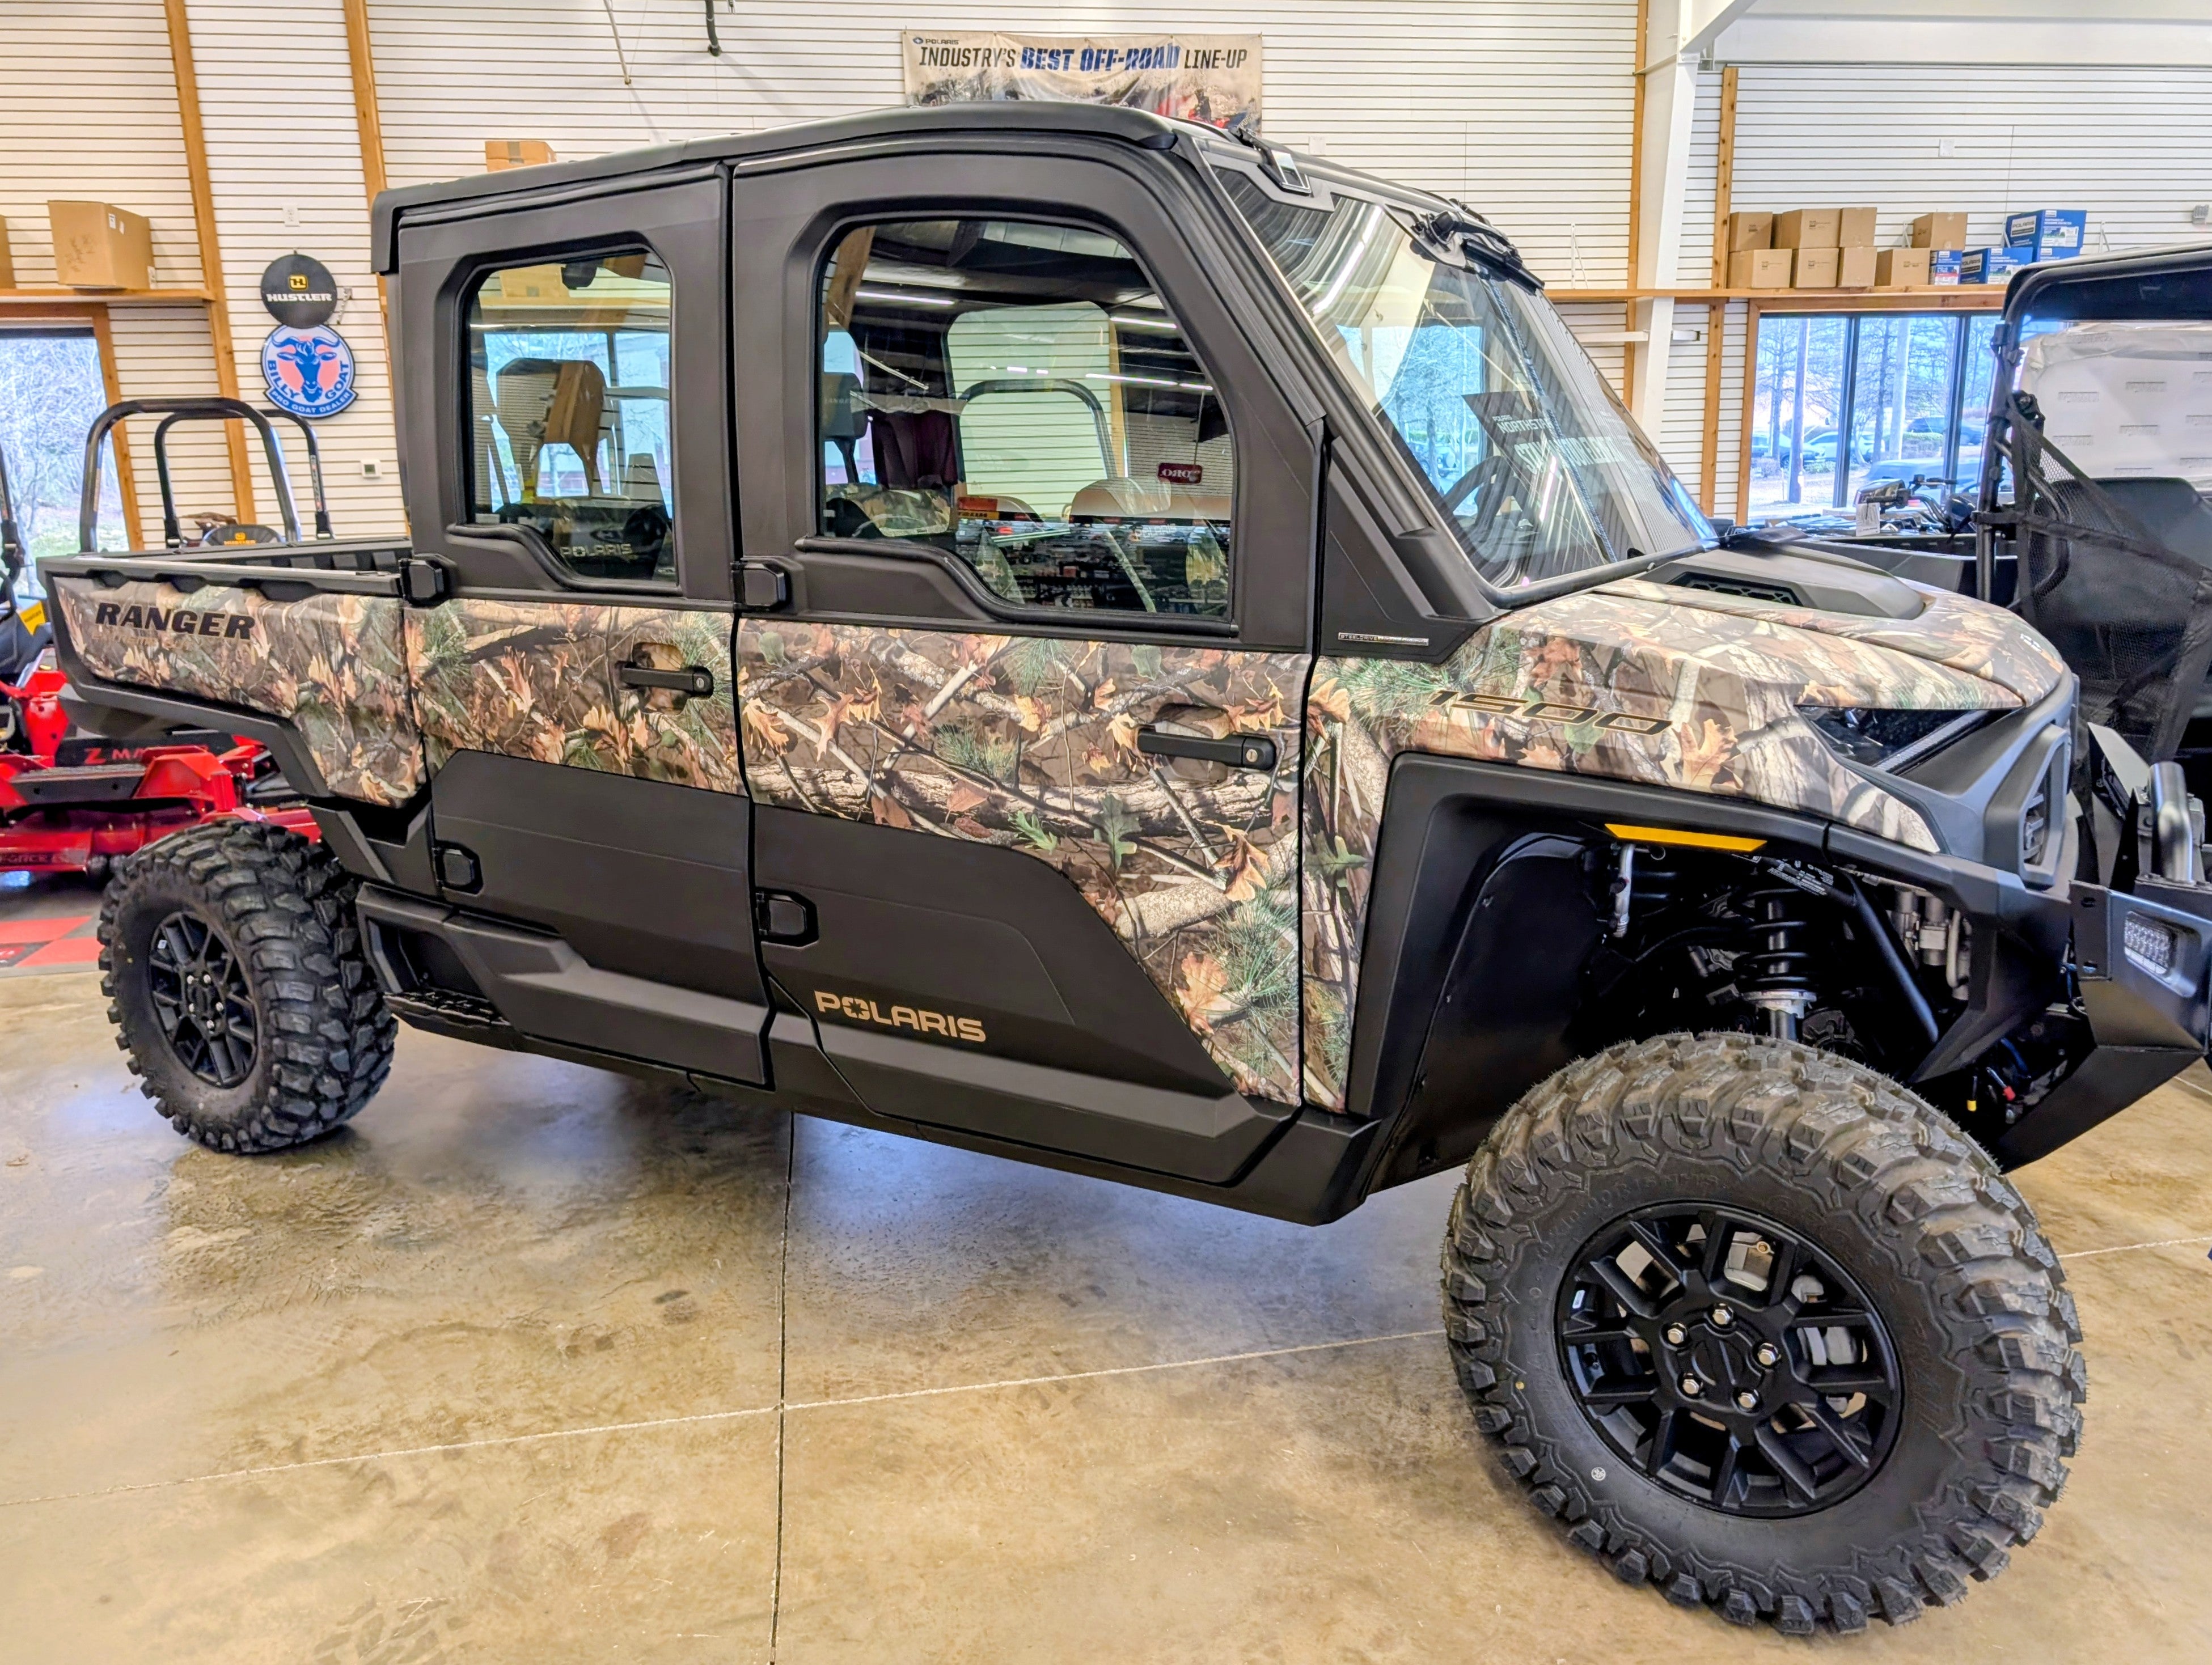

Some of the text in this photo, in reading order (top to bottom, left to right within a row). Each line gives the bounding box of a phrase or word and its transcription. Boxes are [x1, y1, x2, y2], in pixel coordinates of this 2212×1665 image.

[919, 43, 1247, 71] INDUSTRY'S BEST OFF-ROAD LINE-UP
[266, 293, 332, 302] HUSTLER
[268, 360, 349, 400] BILLY GOAT
[272, 390, 351, 414] PRO GOAT DEALER
[559, 543, 632, 558] POLARIS
[95, 602, 256, 640] RANGER
[1428, 690, 1673, 735] 1500
[84, 748, 106, 764] Z
[814, 990, 987, 1042] POLARIS
